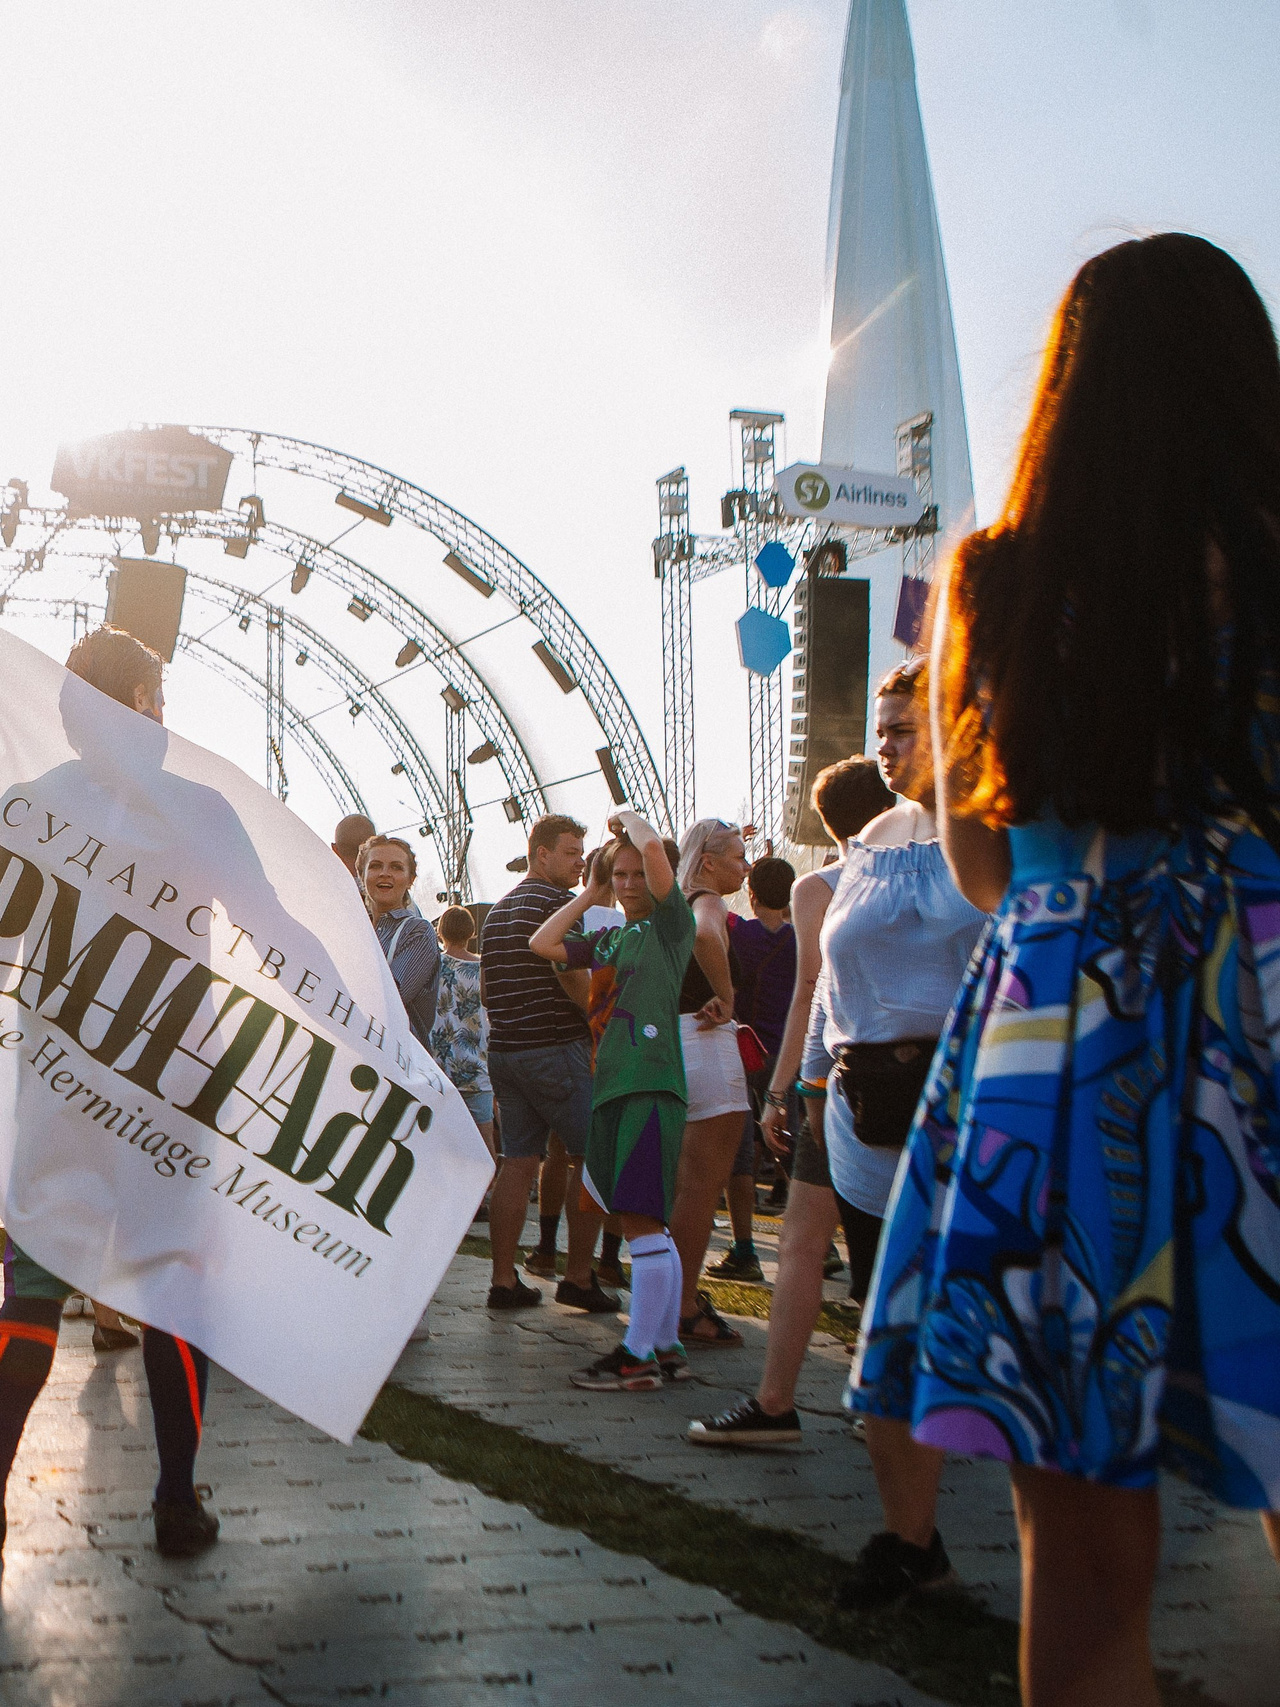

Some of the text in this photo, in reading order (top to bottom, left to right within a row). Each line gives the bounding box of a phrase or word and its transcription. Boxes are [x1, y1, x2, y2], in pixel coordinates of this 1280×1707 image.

[834, 482, 907, 508] Airlines
[27, 1036, 212, 1179] Hermitage
[213, 1163, 375, 1279] Museum
